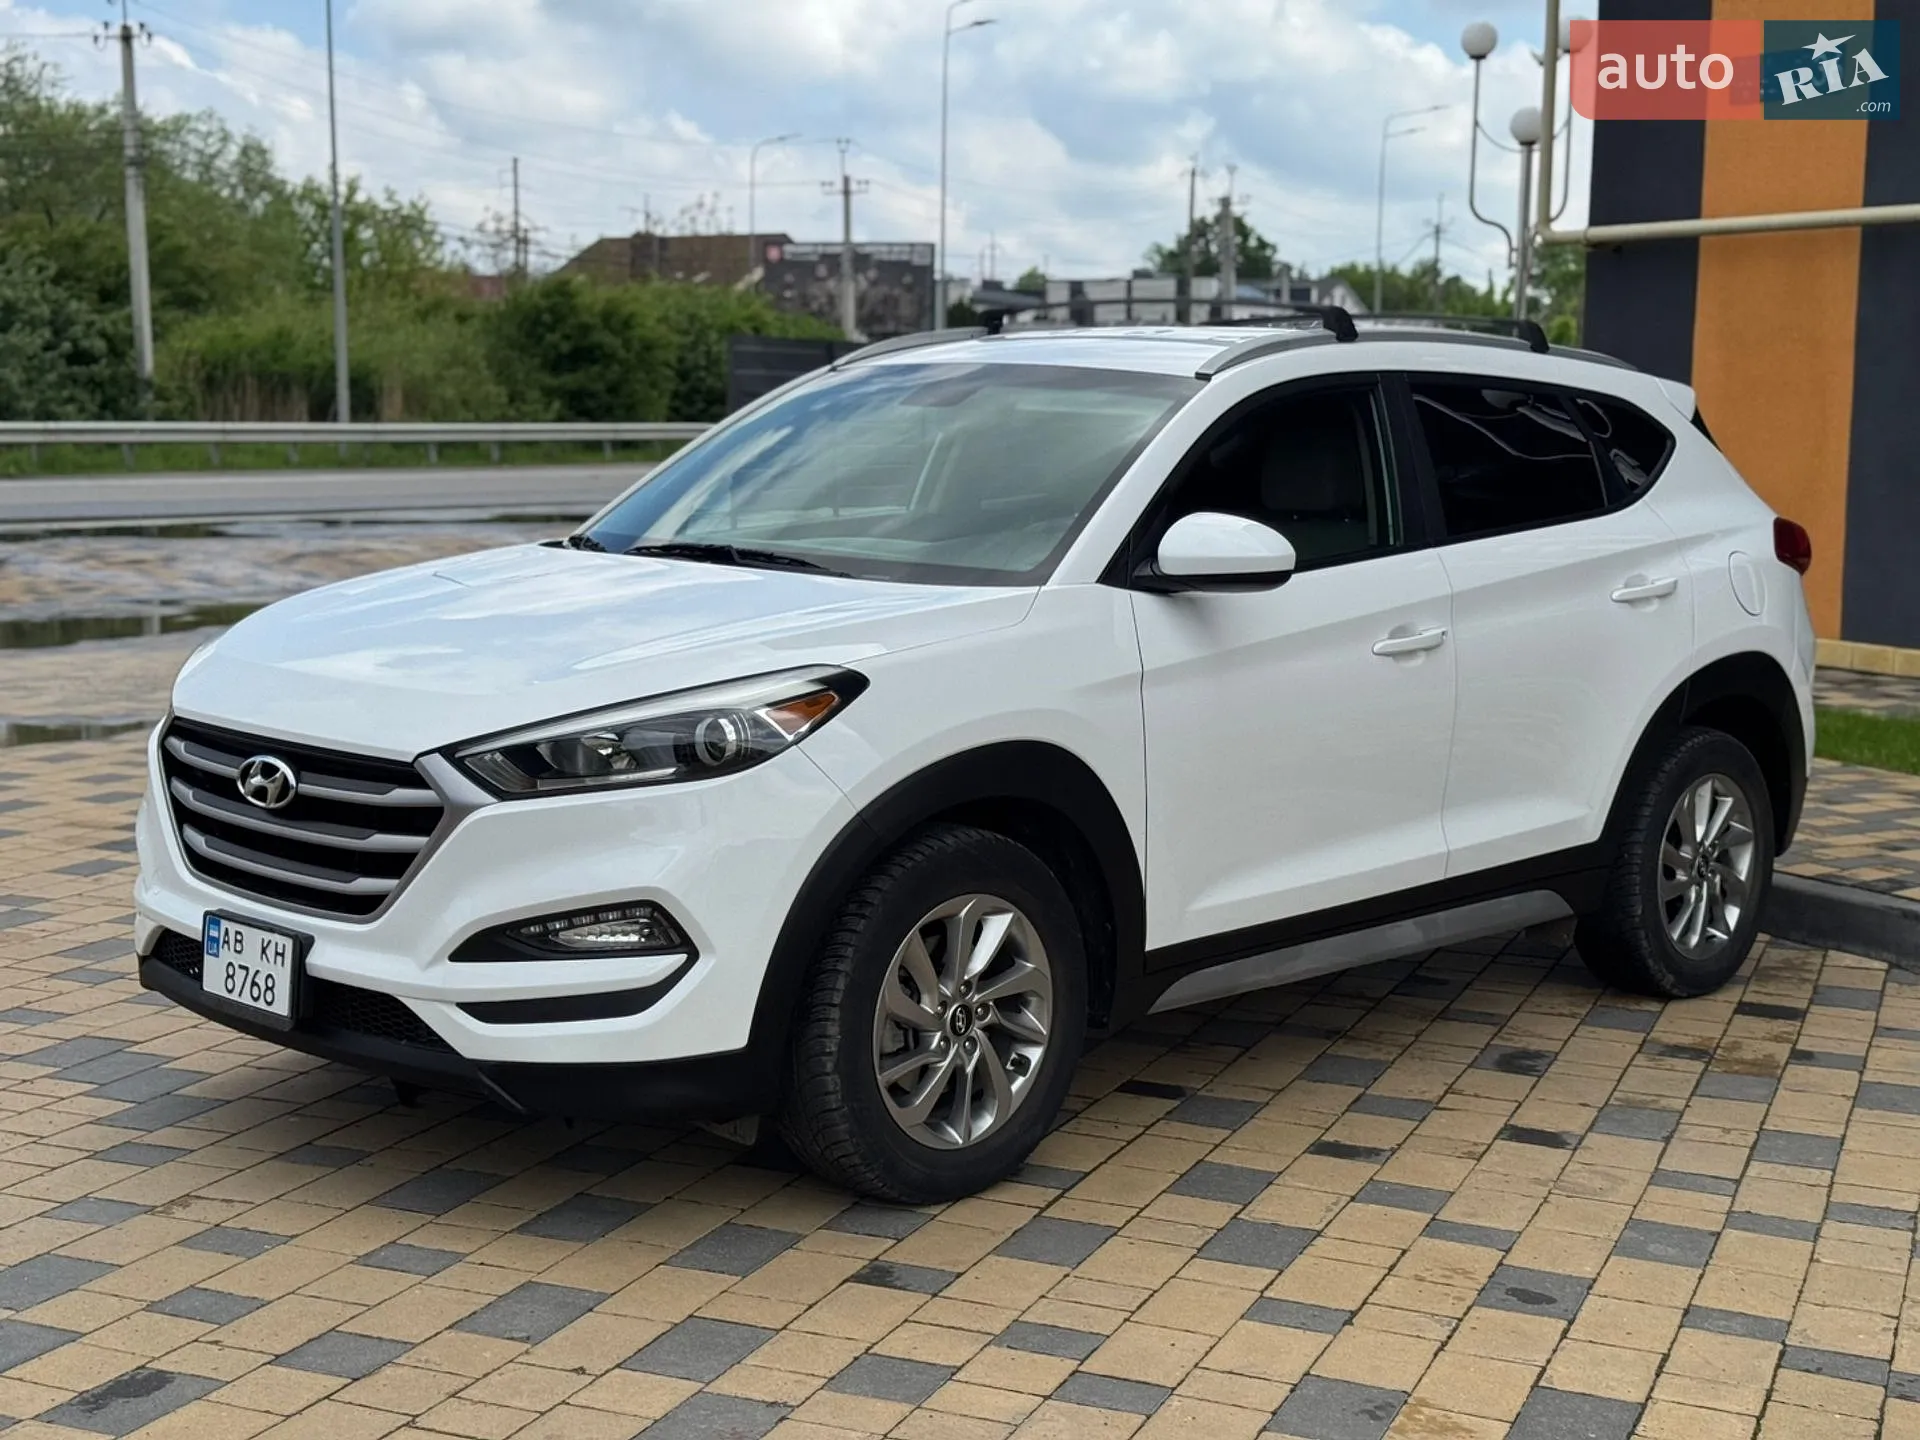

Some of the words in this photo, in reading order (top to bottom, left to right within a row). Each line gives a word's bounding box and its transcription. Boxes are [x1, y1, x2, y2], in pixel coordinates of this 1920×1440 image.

[222, 927, 243, 954] AB
[261, 938, 286, 967] KH
[225, 962, 275, 1006] 8768
